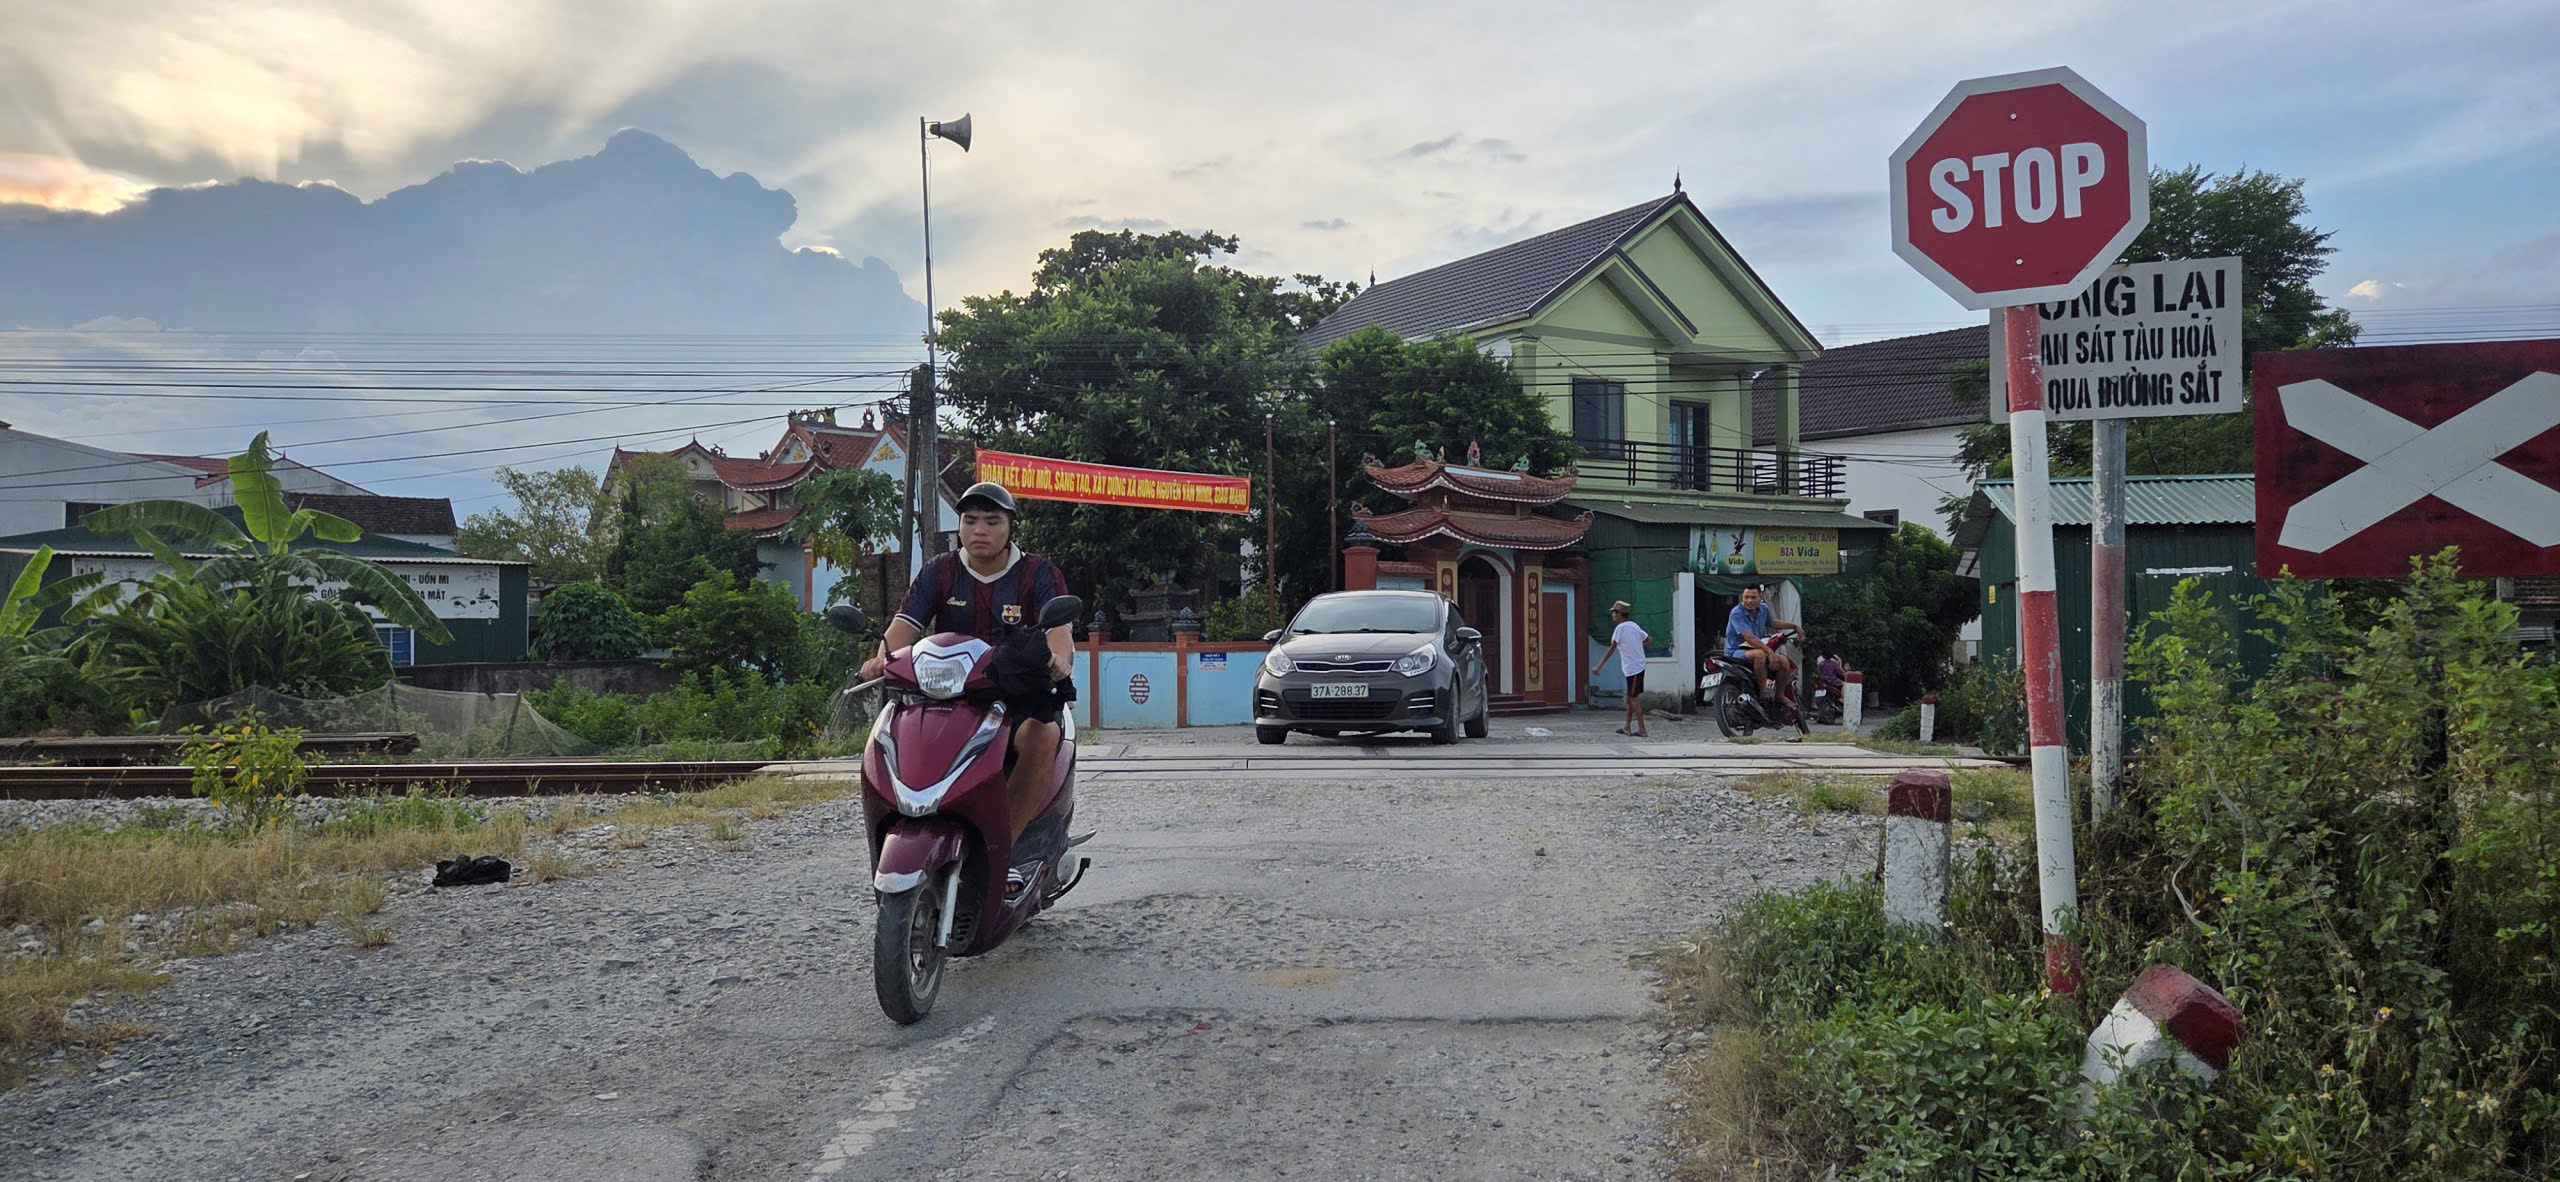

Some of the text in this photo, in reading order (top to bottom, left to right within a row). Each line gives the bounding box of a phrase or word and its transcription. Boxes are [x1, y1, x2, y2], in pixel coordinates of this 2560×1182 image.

[1928, 141, 2106, 234] STOP
[2038, 269, 2226, 320] NG LẠI
[2041, 316, 2217, 366] AN SÁT TÀU HOẢ
[2047, 377, 2092, 415] QUA
[2097, 365, 2173, 408] ĐƯỜNG
[2179, 360, 2223, 404] SẮT
[1054, 467, 1075, 492] SÁNG
[1728, 557, 1744, 566] Vida
[1780, 546, 1819, 557] BIA Vida
[438, 574, 449, 584] MI
